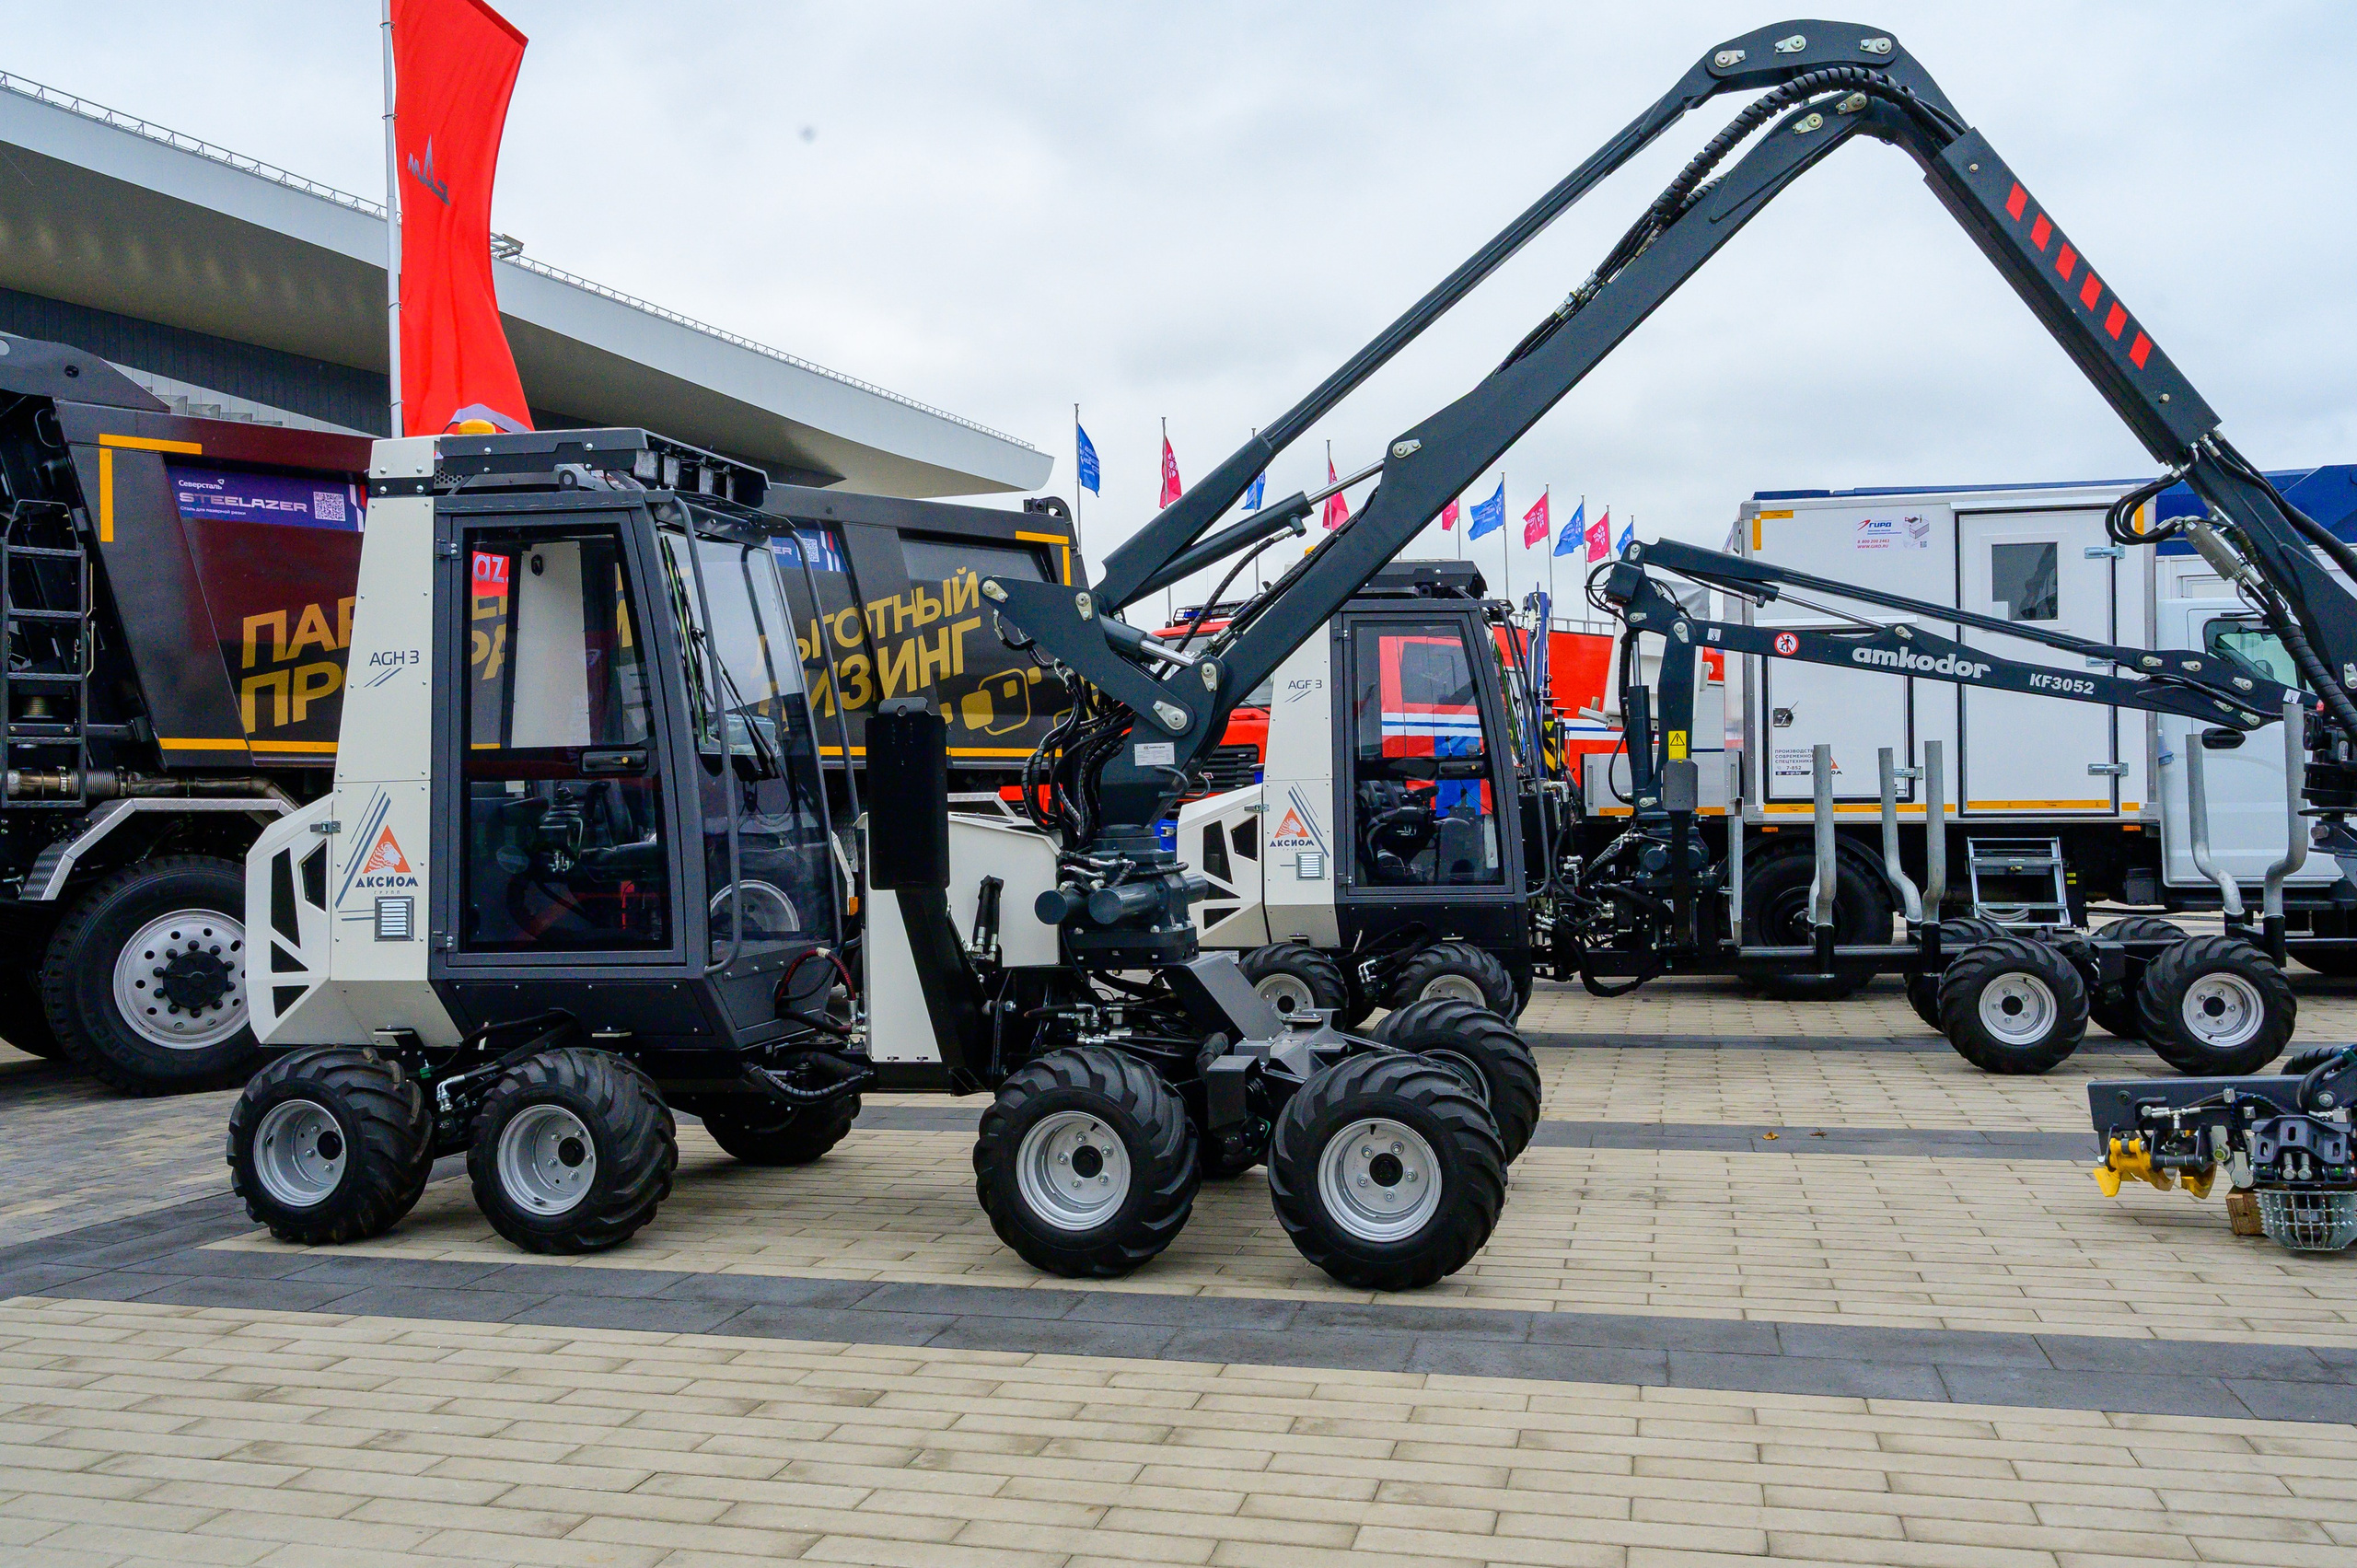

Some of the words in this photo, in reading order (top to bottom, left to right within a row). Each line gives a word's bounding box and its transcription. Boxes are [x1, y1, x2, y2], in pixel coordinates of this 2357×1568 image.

[179, 480, 223, 490] Северсталь
[180, 492, 308, 513] STEELAZER
[369, 651, 405, 666] AGH
[409, 650, 419, 664] 3
[1852, 646, 1991, 679] amkodor
[1288, 679, 1312, 690] AGF
[1315, 679, 1322, 689] 3
[2029, 673, 2095, 695] KF3052
[1270, 839, 1315, 847] АКСИОМ
[355, 876, 418, 888] АКСИОМ
